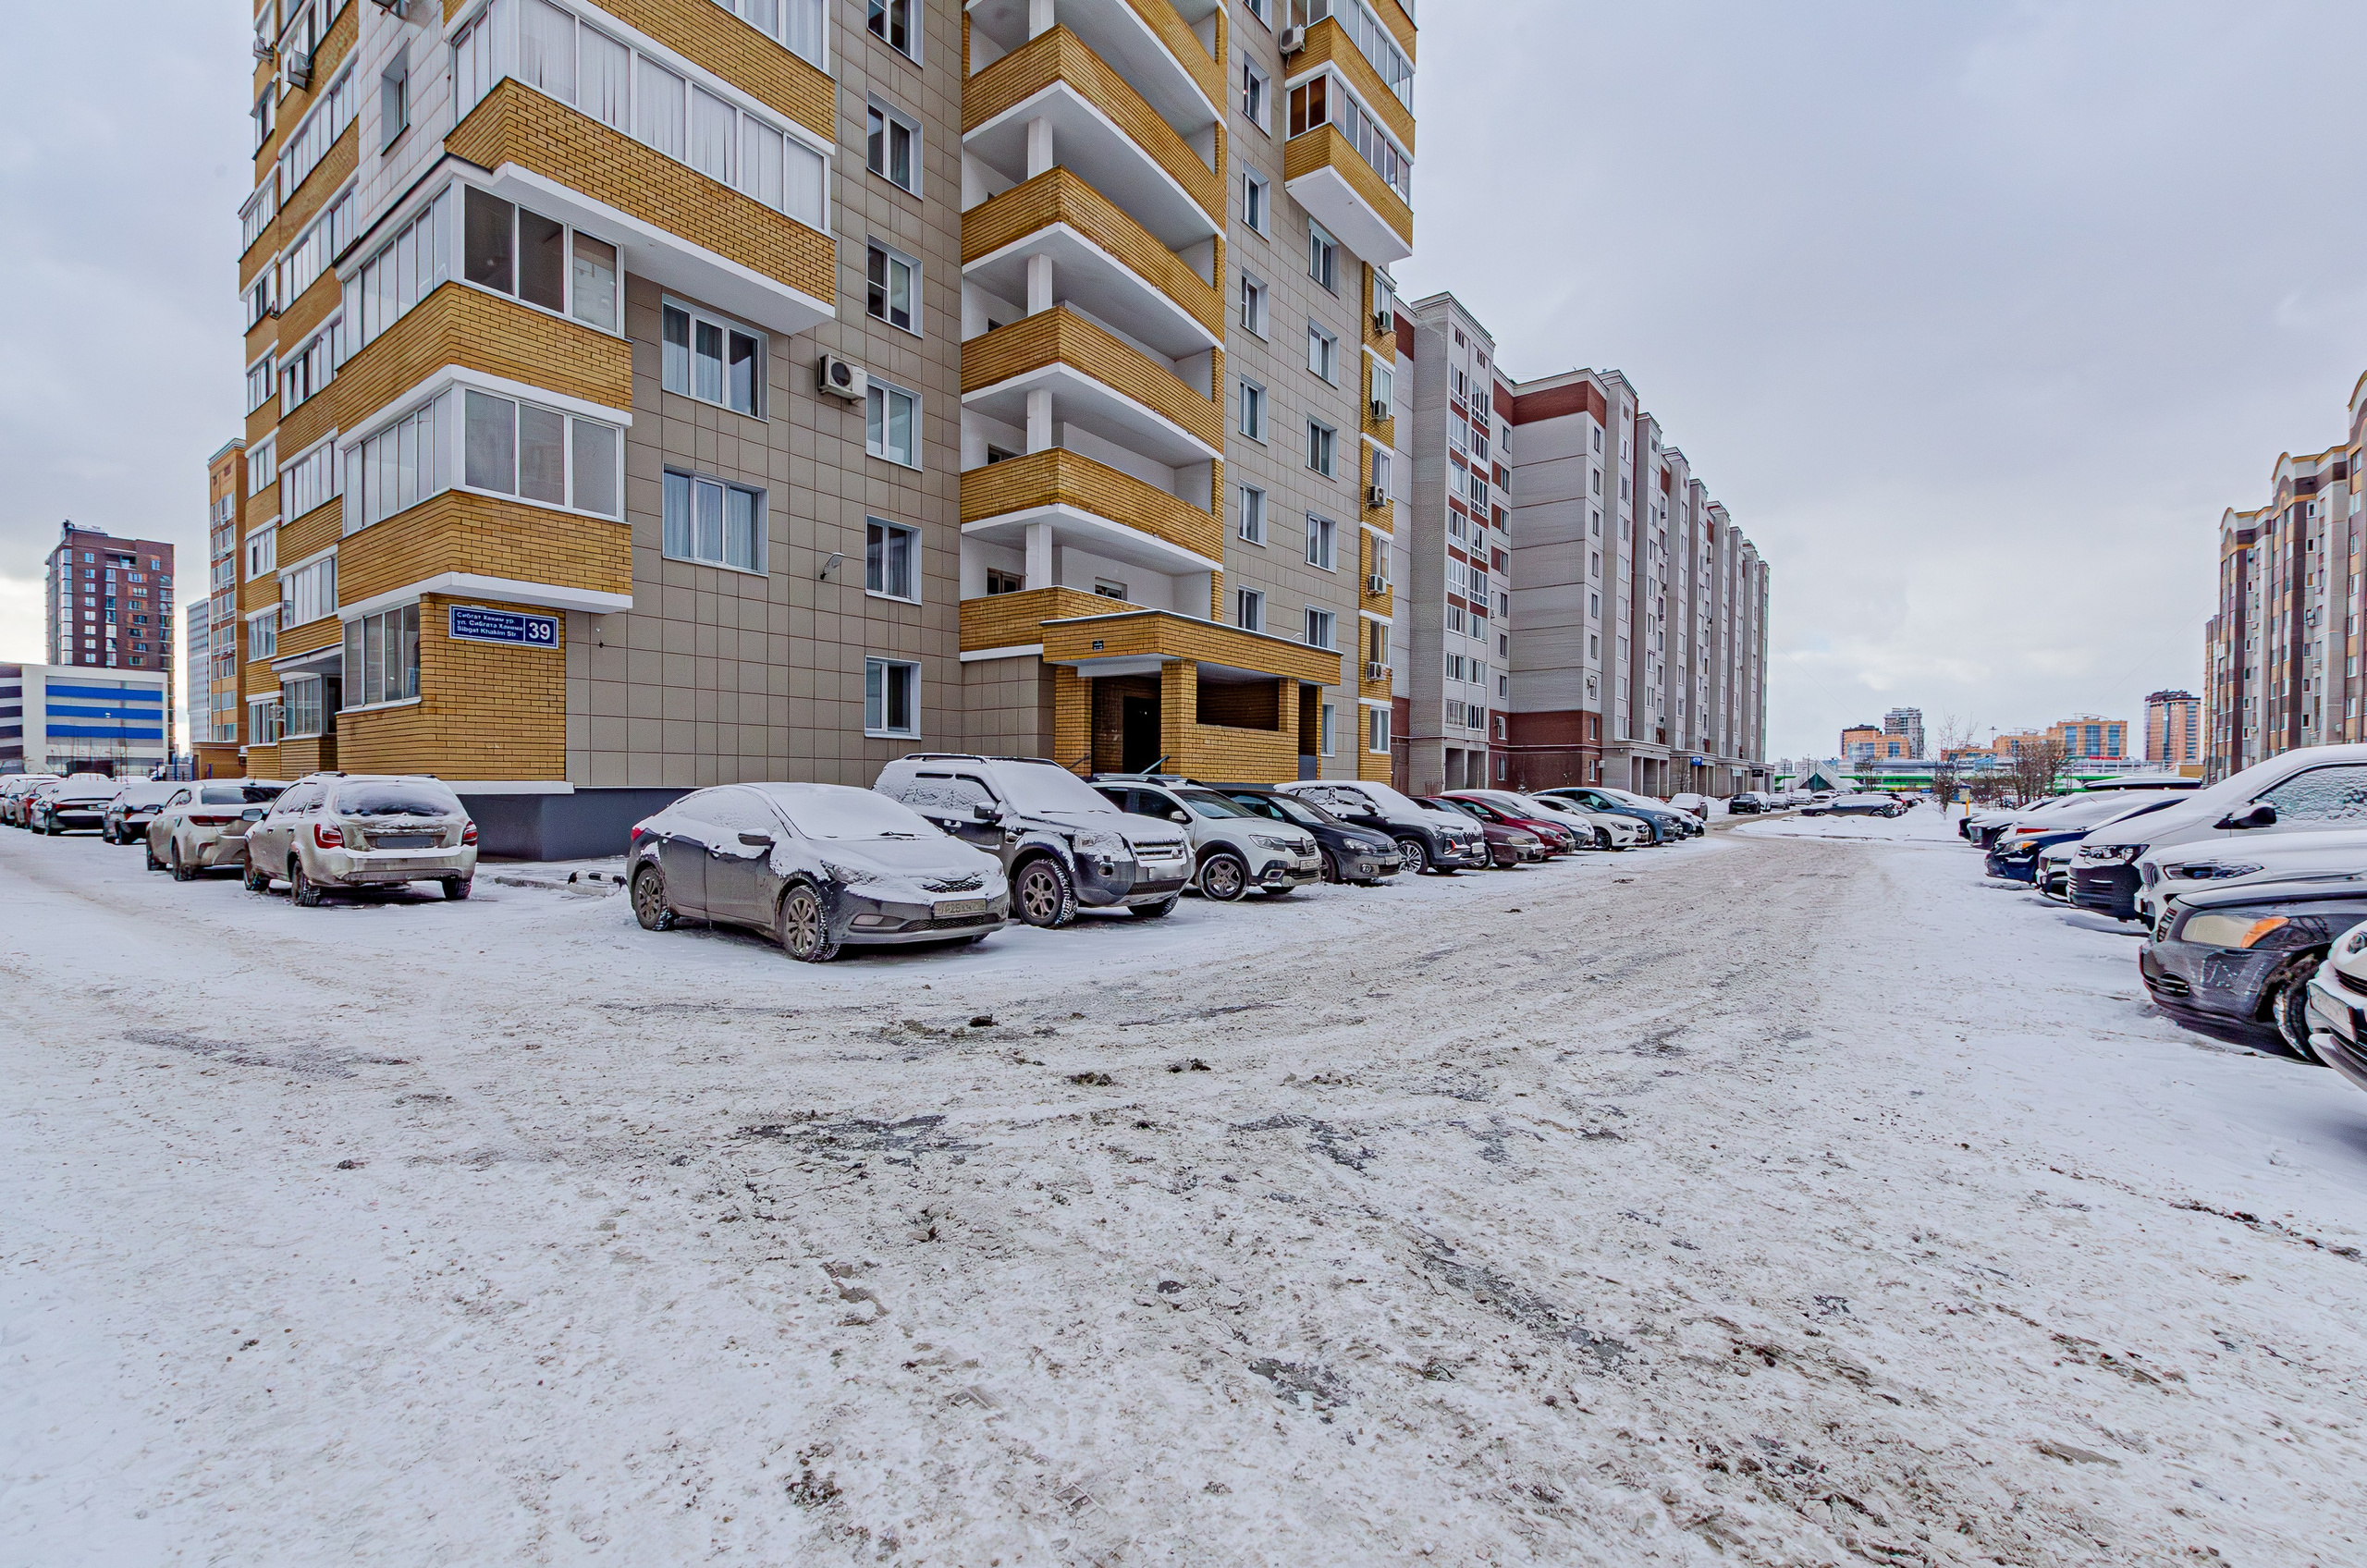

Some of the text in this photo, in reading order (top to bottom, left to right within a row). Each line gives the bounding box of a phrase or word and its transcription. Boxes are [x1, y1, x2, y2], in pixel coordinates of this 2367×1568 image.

[457, 612, 481, 620] Сибгат
[469, 619, 497, 629] Сибгата
[498, 623, 523, 631] Хакима
[528, 621, 551, 640] 39
[457, 626, 479, 634] Sibgat
[481, 628, 506, 636] Khakim
